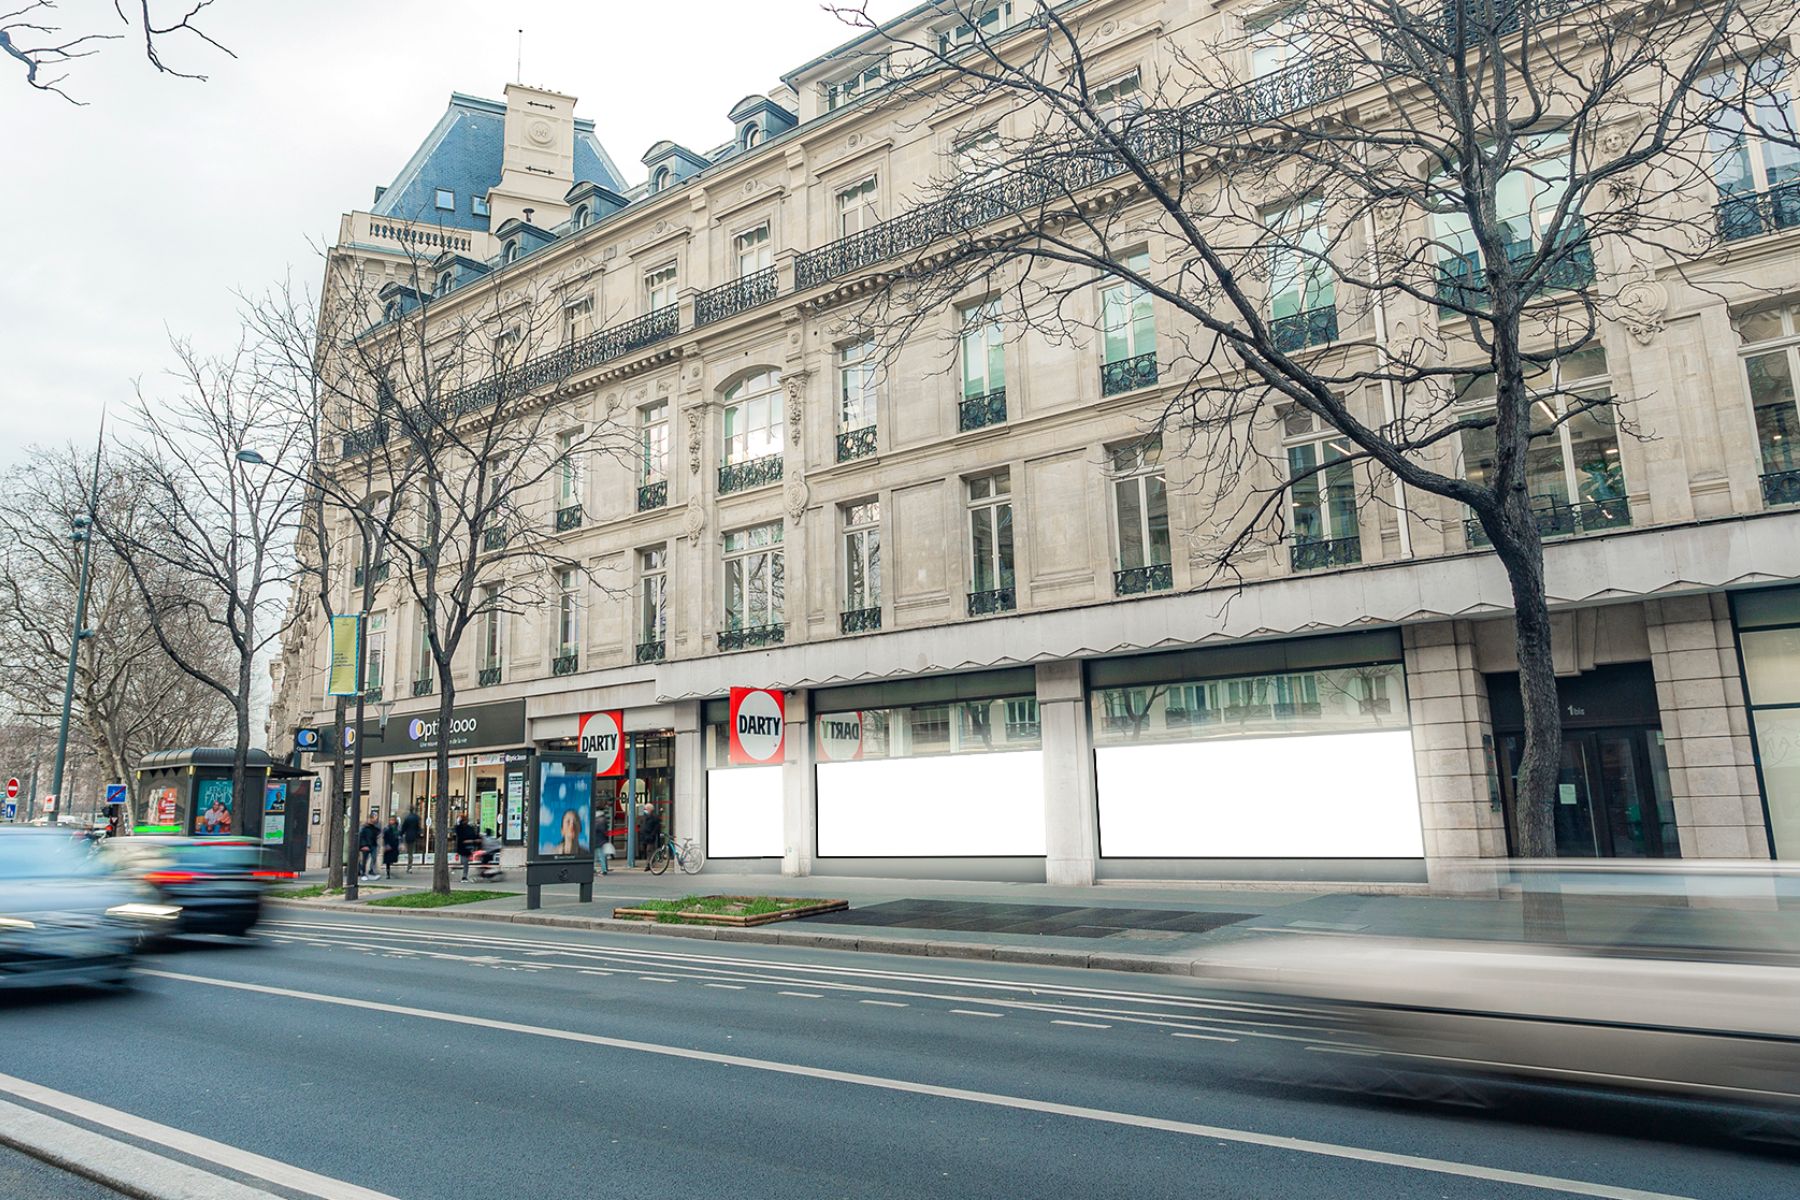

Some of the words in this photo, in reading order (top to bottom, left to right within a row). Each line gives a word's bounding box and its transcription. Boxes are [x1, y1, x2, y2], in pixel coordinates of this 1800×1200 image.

[416, 718, 441, 742] Opti
[738, 714, 781, 736] DARTY
[581, 733, 618, 753] DARTY
[621, 791, 649, 804] DRTY
